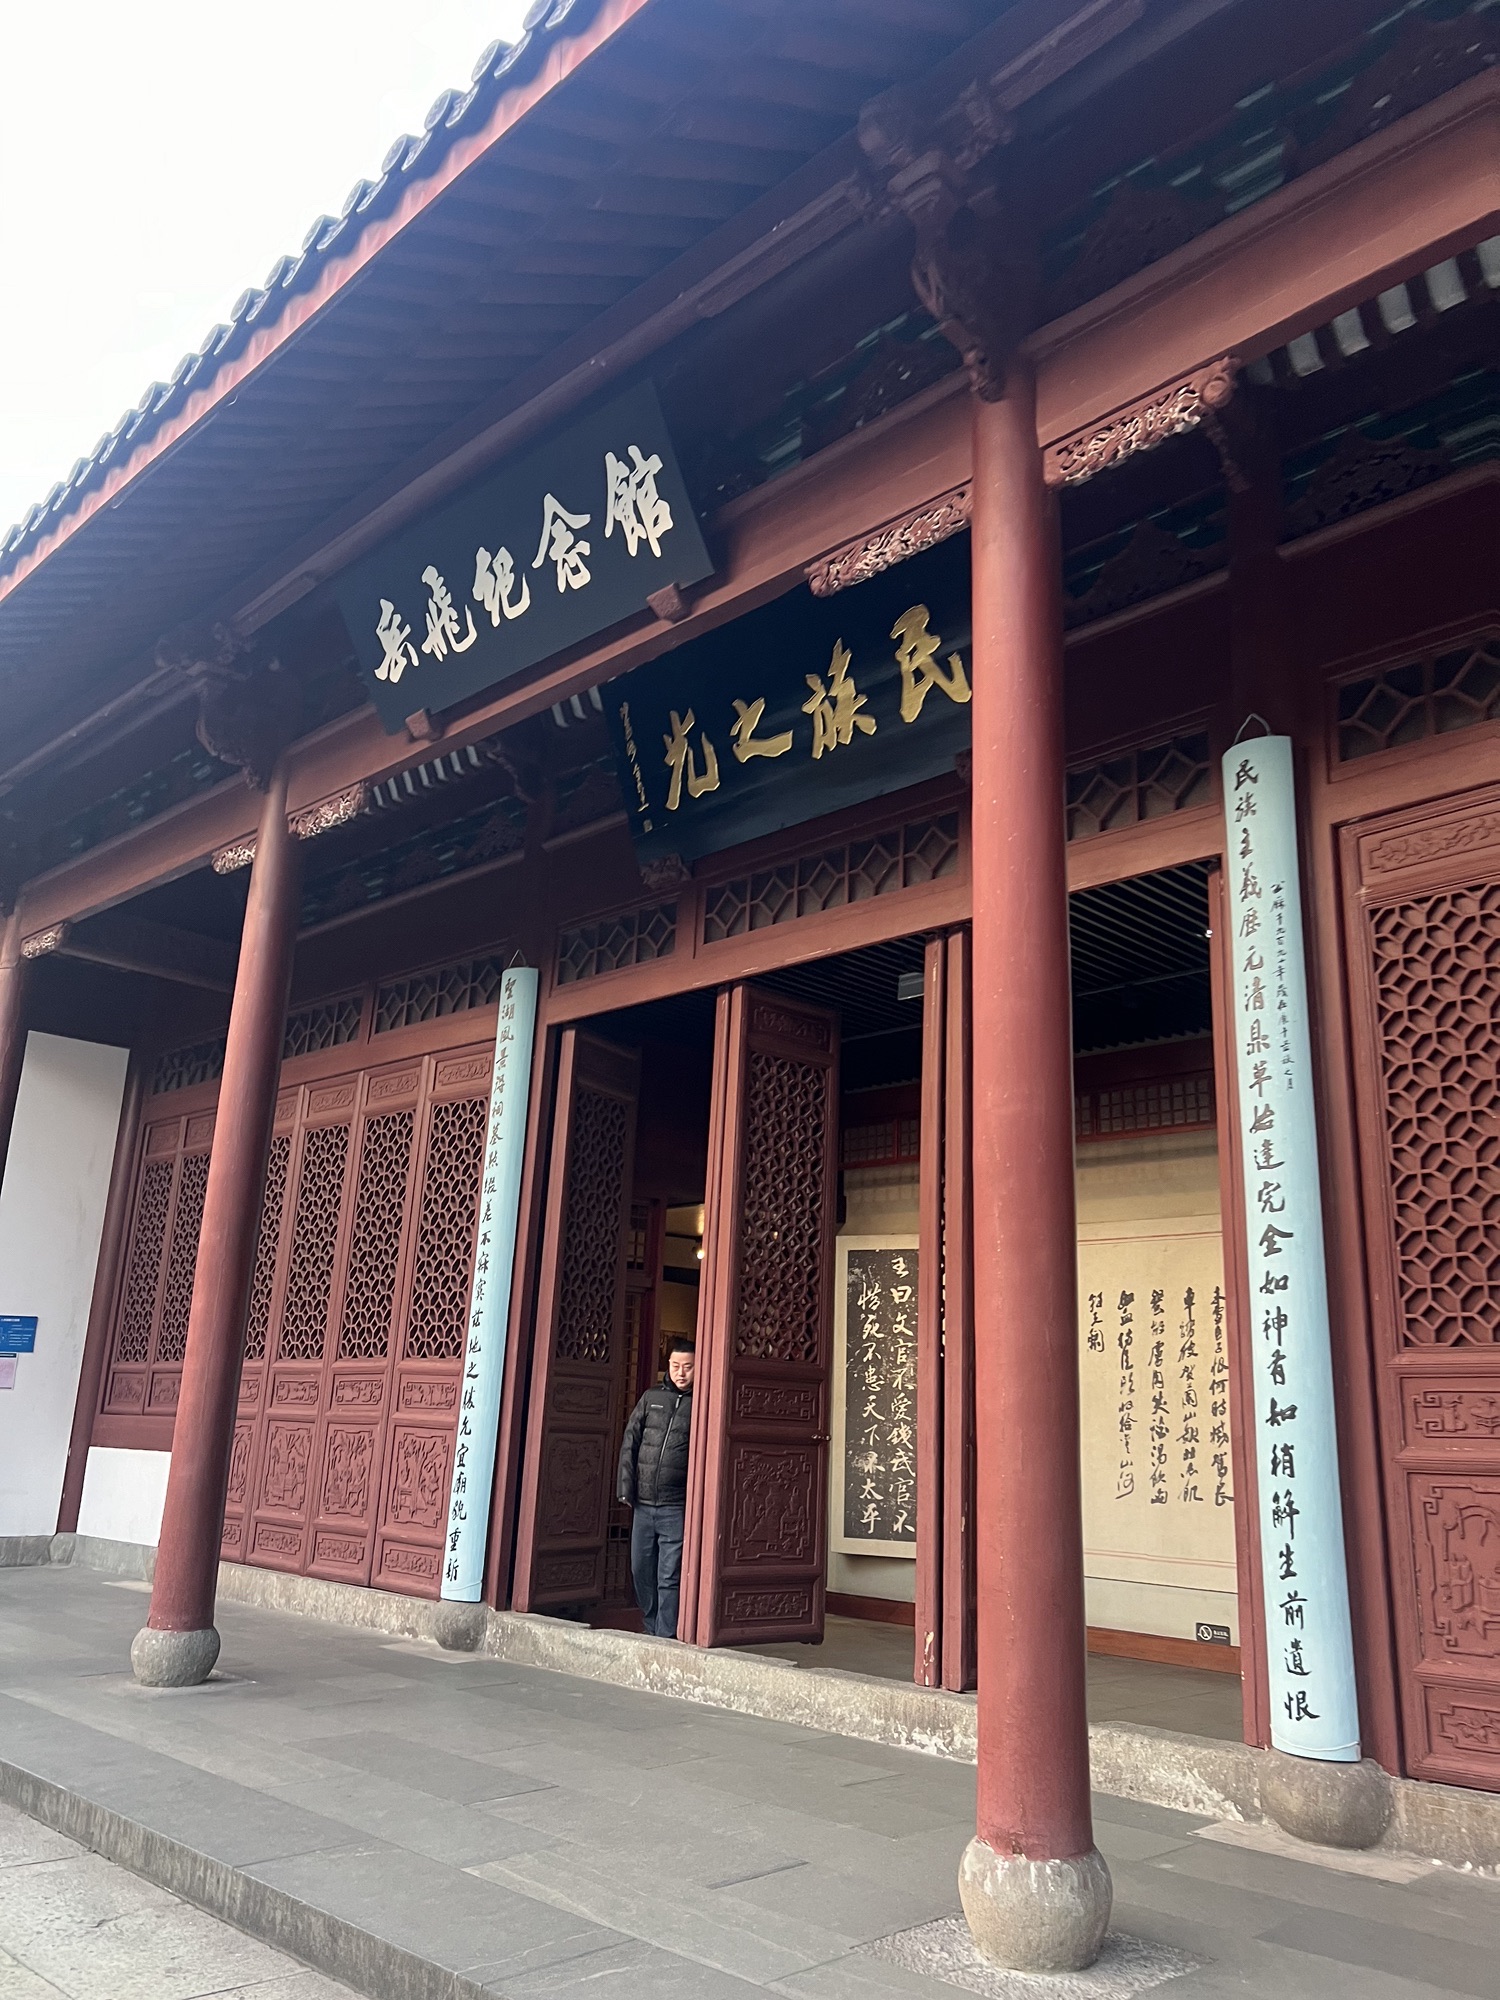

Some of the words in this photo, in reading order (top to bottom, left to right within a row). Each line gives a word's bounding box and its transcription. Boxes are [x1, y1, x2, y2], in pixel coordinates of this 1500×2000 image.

[374, 445, 674, 684] 岳飛紀念館
[664, 604, 971, 810] 民族之光
[858, 1282, 886, 1534] 惜死不患天下不太平
[886, 1256, 916, 1534] 王曰文官不愛錢武官不
